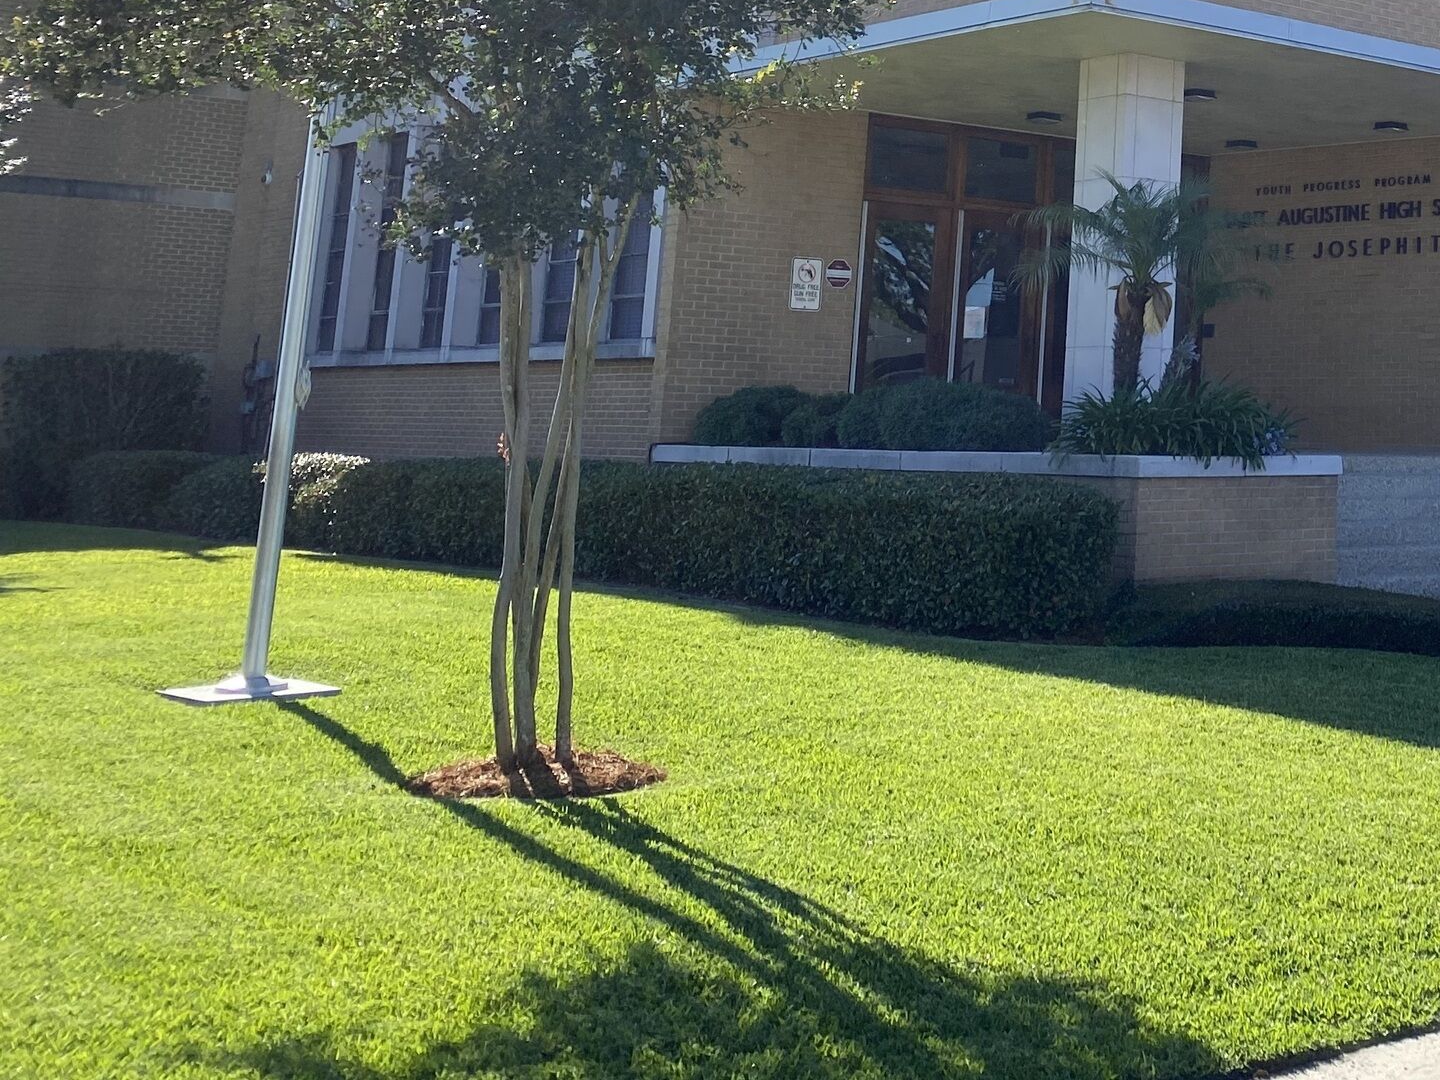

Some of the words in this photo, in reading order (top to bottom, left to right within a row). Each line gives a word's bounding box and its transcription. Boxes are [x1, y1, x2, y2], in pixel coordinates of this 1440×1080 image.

[1256, 185, 1292, 196] YOUTH
[1303, 179, 1361, 192] PROGRESS
[1375, 174, 1431, 188] PROGRAM
[1276, 203, 1370, 226] AUGUSTINE
[1379, 200, 1422, 219] HIGH
